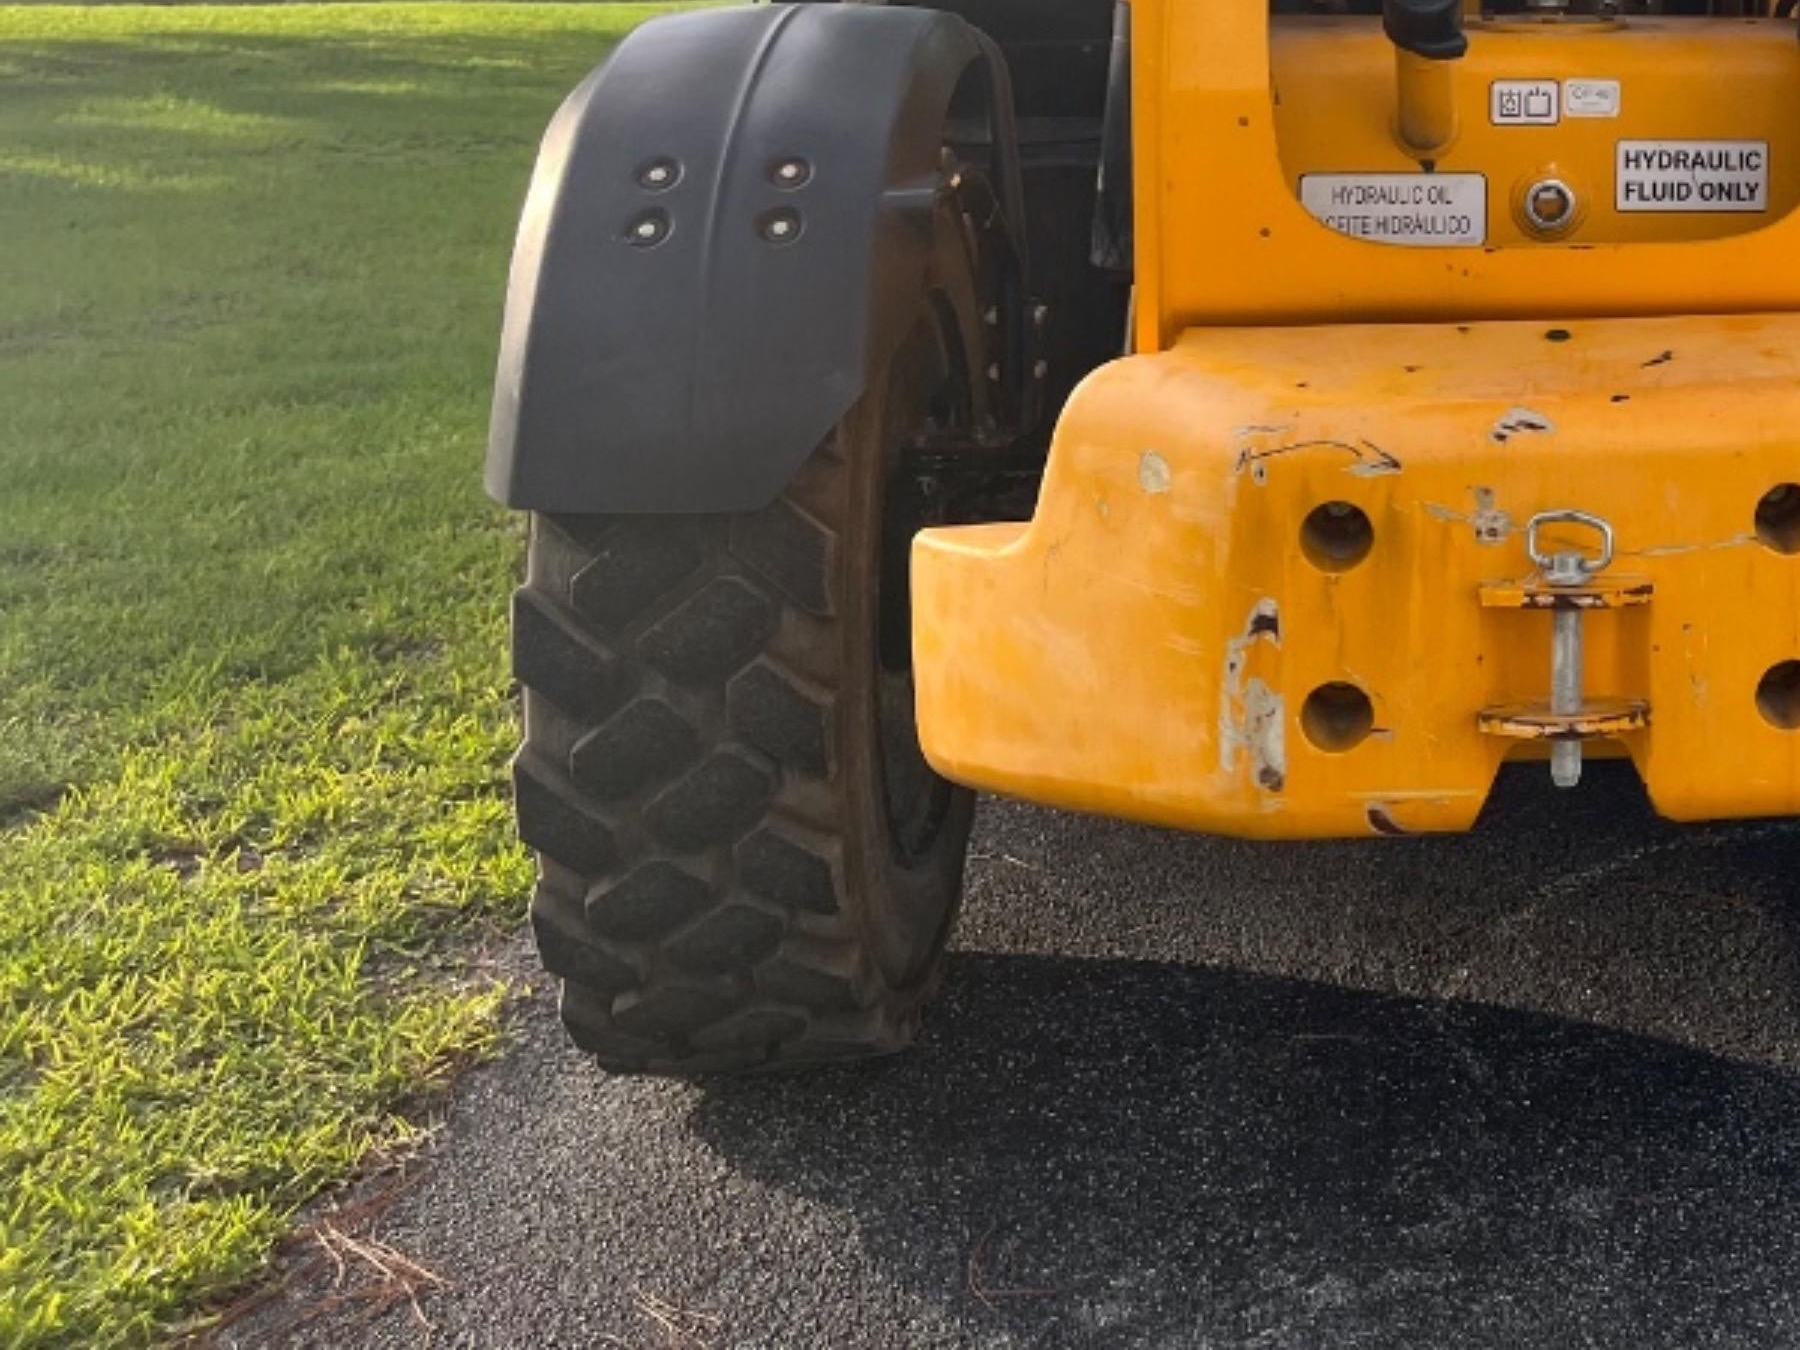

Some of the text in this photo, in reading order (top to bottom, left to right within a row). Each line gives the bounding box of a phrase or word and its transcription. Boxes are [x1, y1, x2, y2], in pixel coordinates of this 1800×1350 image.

[1624, 150, 1761, 171] HYDRAULIC
[1332, 186, 1452, 205] HYDRAULIC OIL
[1624, 182, 1759, 201] FLUID ONLY
